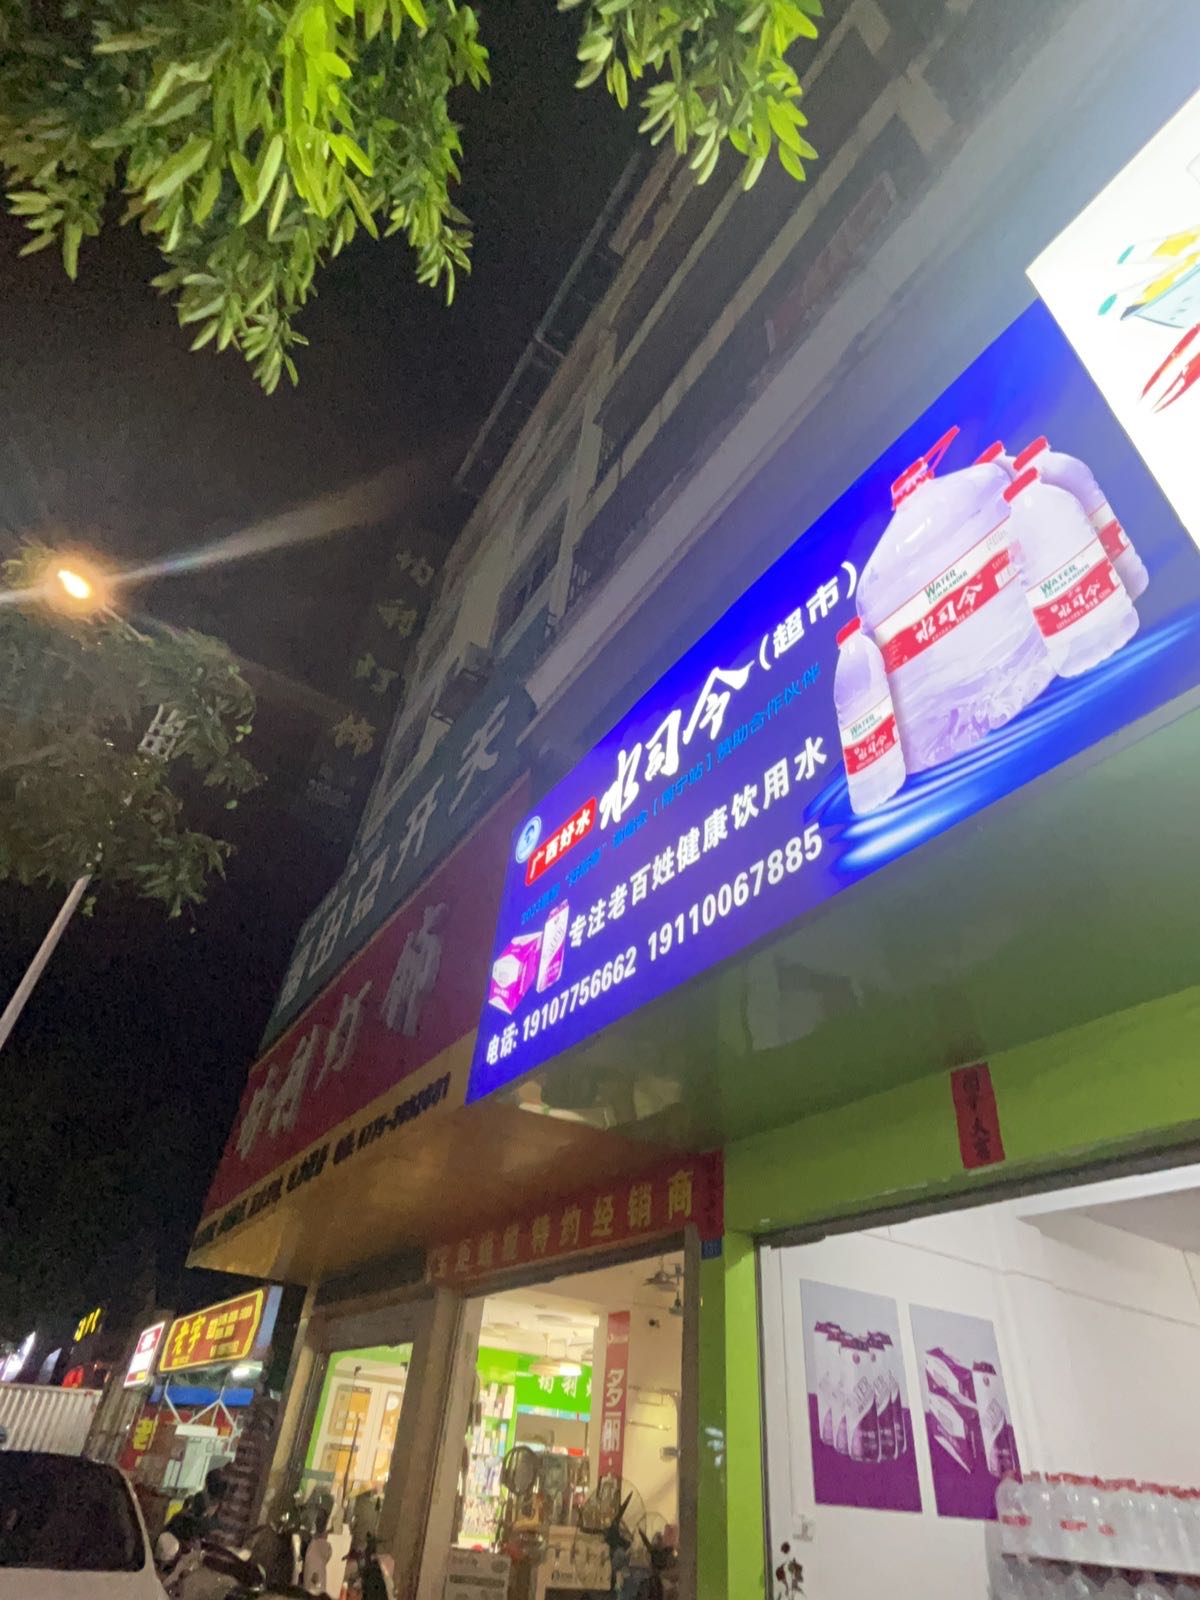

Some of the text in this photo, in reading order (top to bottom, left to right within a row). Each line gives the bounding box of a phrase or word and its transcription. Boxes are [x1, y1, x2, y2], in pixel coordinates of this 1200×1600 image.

[915, 583, 983, 643] 水司令
[925, 569, 957, 598] WATER
[1040, 564, 1077, 593] WATER
[598, 661, 755, 831] 水司令
[529, 807, 592, 880] 广西好水
[568, 736, 828, 948] 专注老百姓健康饮用水
[522, 945, 637, 1042] 19107756662
[647, 822, 824, 961] 19110067885
